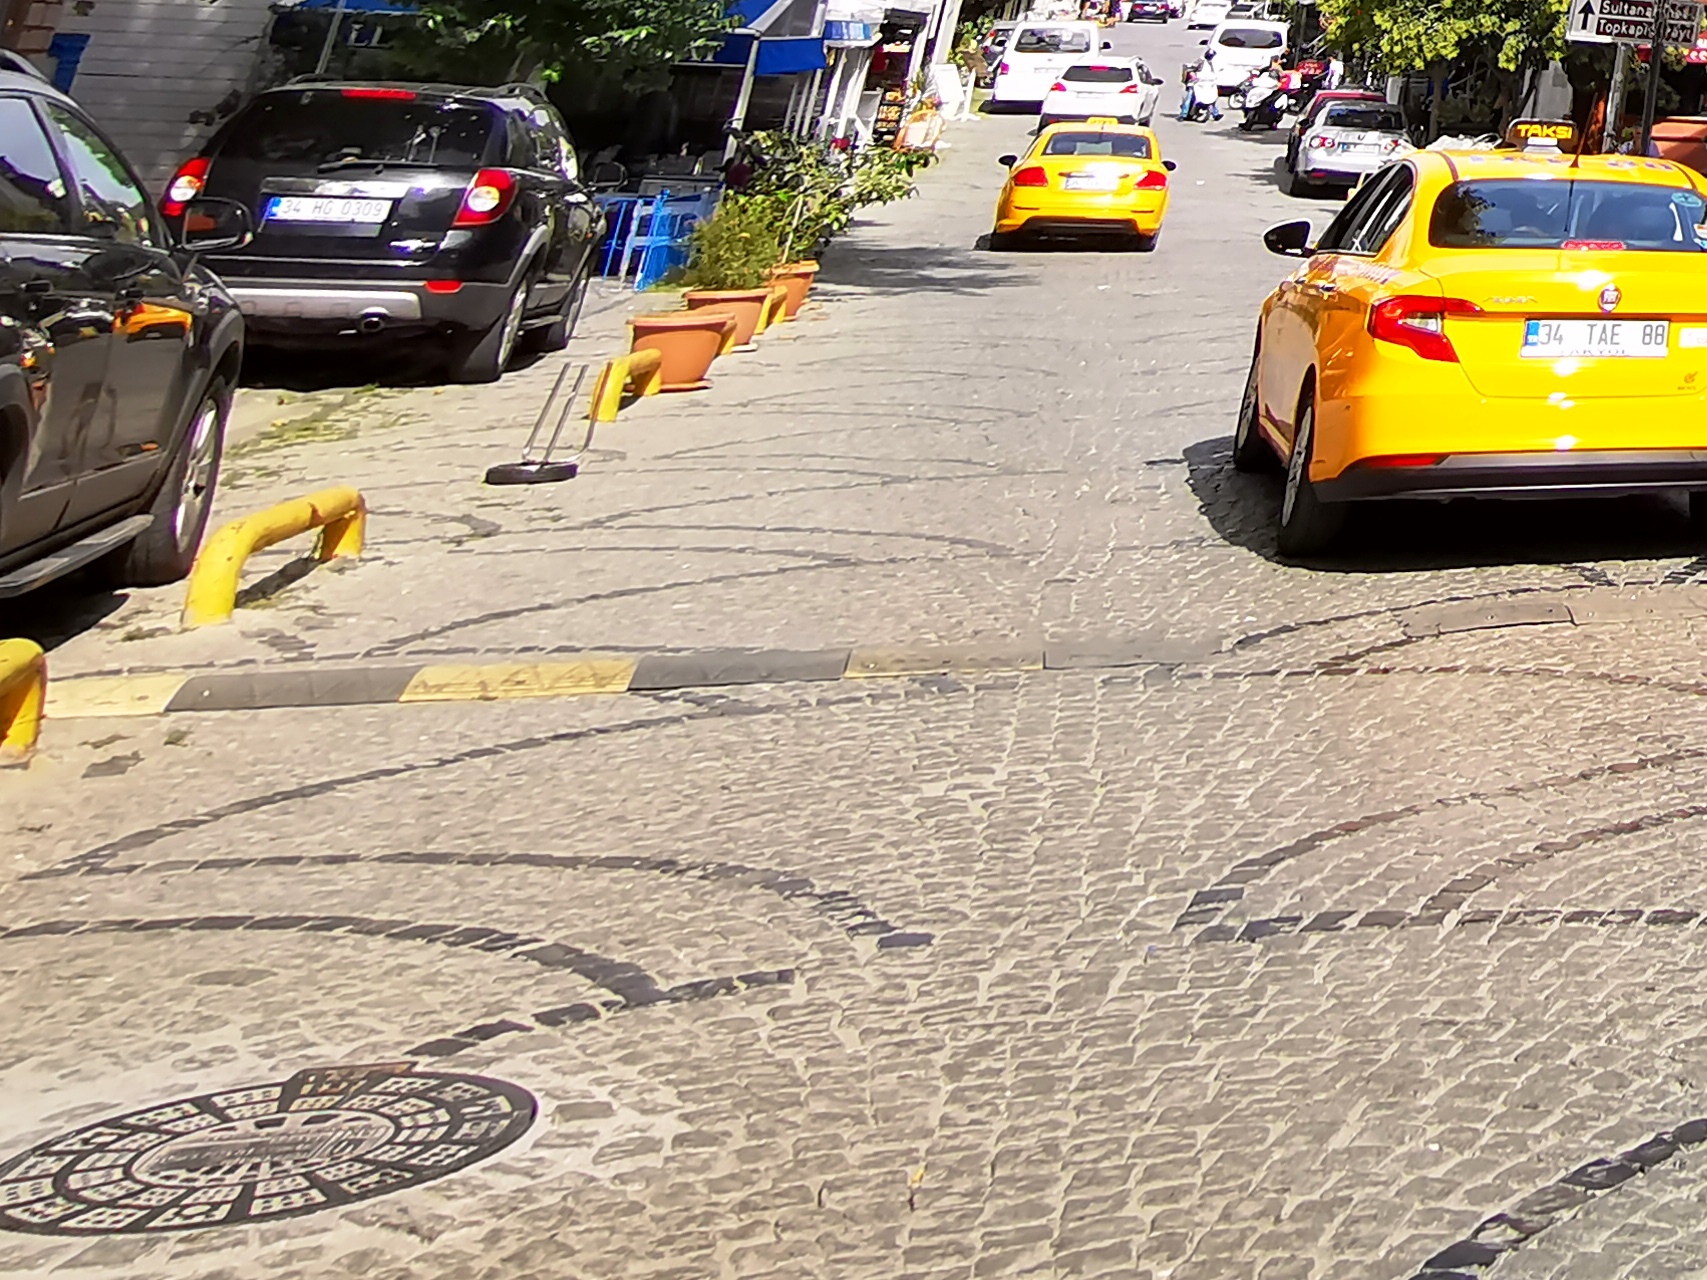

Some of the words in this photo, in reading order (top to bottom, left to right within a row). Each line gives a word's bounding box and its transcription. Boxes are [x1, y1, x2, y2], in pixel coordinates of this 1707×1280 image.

[281, 199, 301, 213] 34
[312, 200, 334, 215] HG
[341, 202, 384, 217] 0309
[1539, 324, 1564, 346] 34
[1586, 324, 1622, 346] TAE
[1641, 324, 1666, 346] 88
